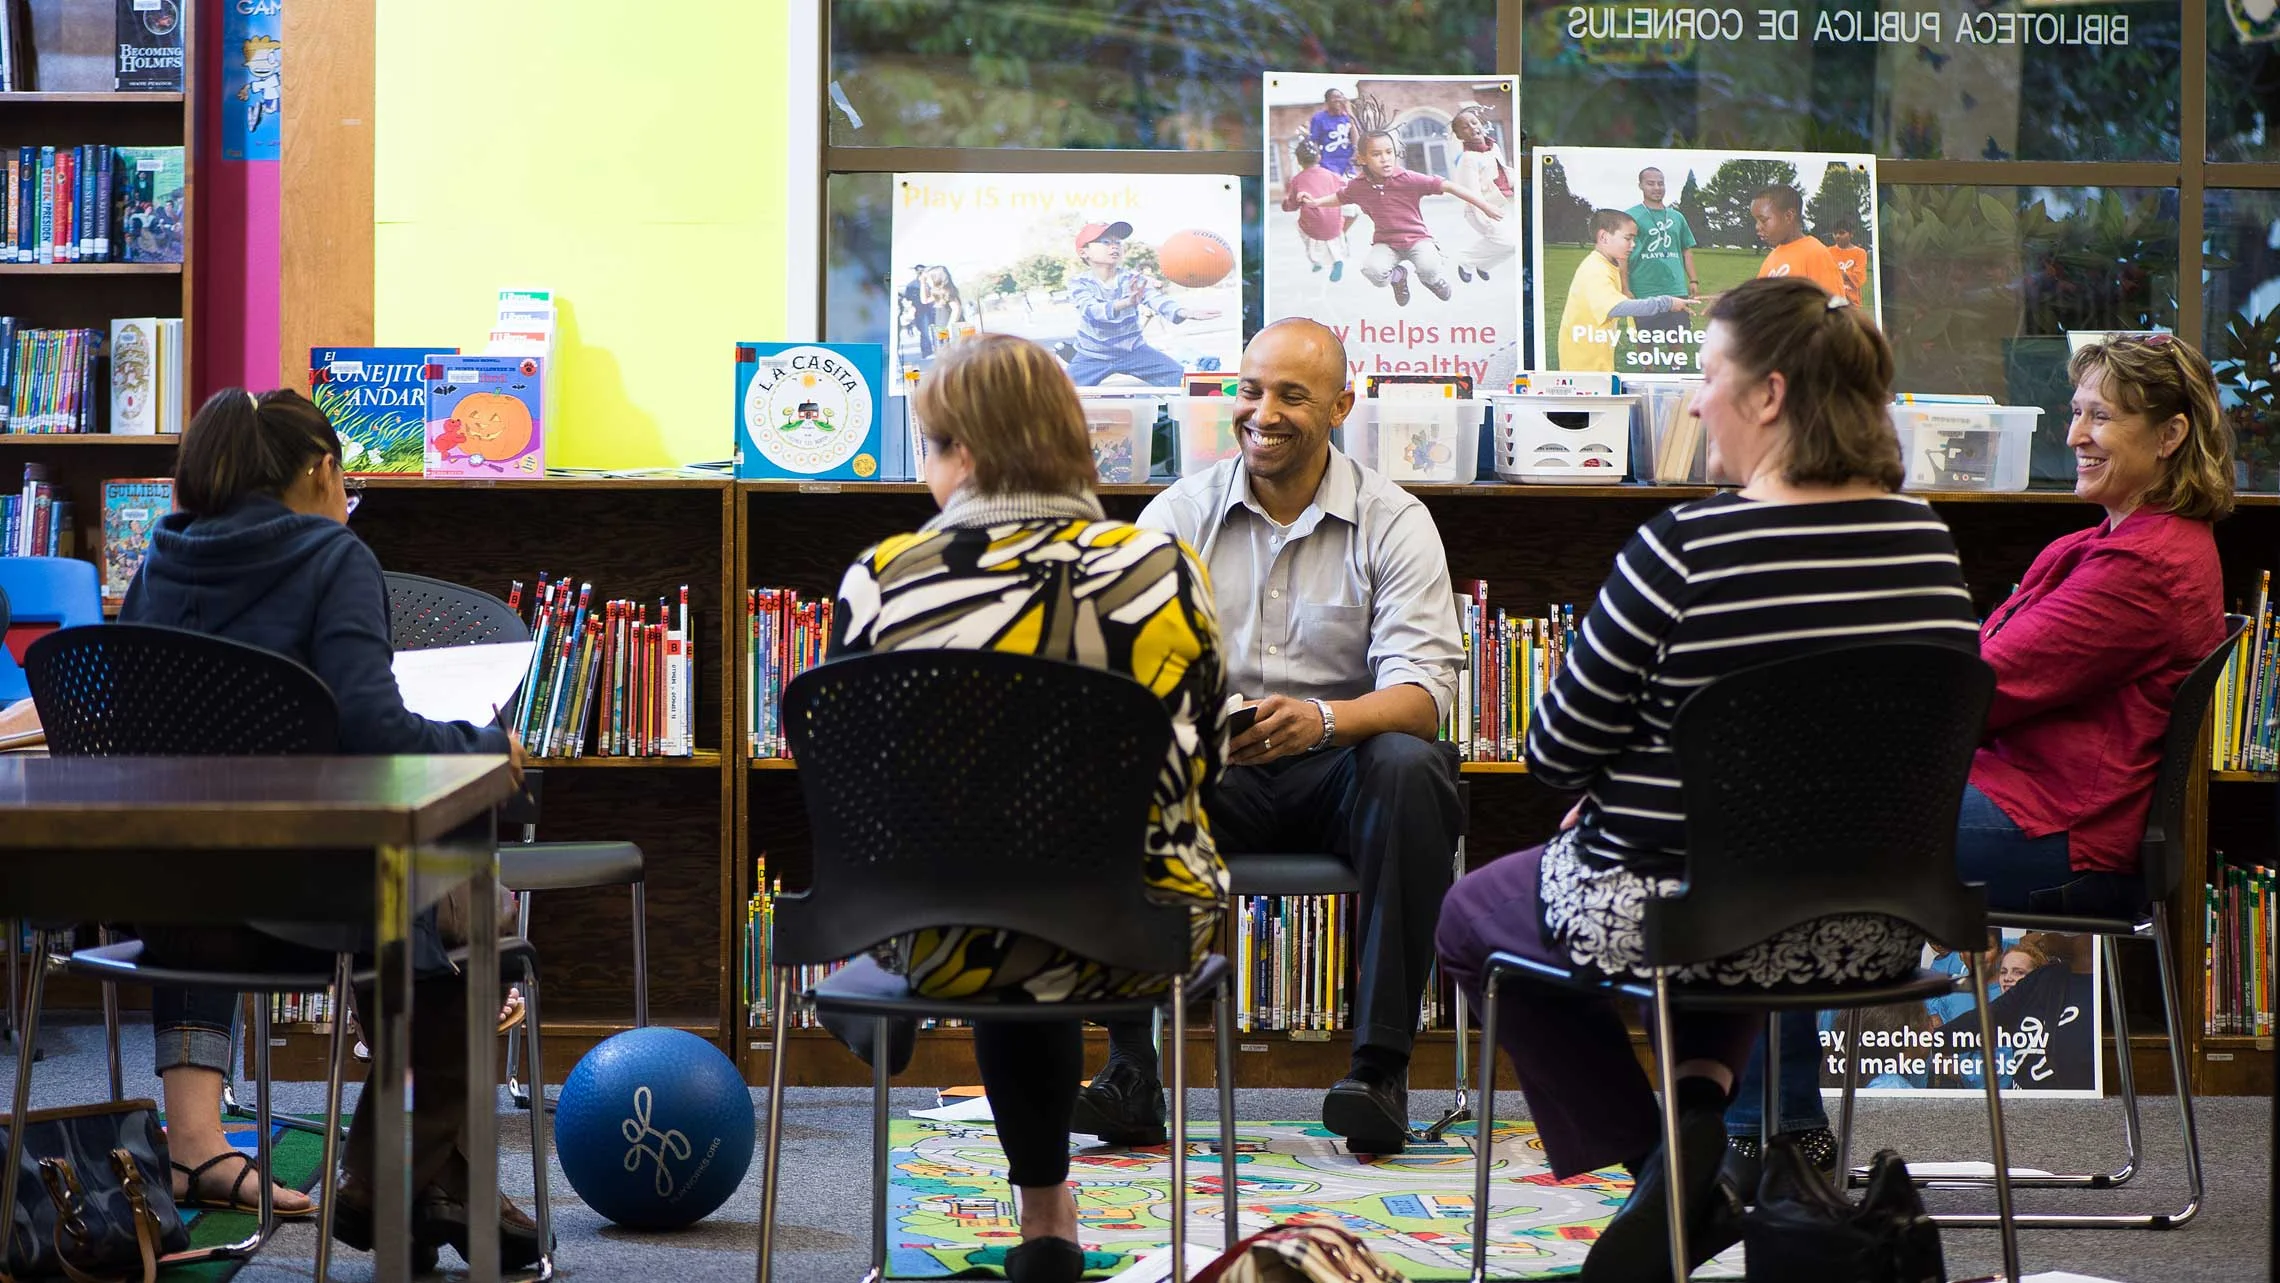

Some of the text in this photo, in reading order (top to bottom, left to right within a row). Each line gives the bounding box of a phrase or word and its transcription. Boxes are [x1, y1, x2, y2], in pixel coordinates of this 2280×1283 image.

[120, 44, 181, 56] BECOMING
[120, 55, 182, 73] HOLMES
[903, 185, 963, 211] Play
[1011, 190, 1053, 211] my
[1065, 186, 1138, 209] work
[41, 205, 52, 242] PRESIDEN
[1360, 319, 1440, 349] helps
[1450, 326, 1496, 344] me
[1572, 324, 1707, 347] Play teache
[1375, 354, 1489, 384] healthy
[1626, 347, 1688, 366] solve
[759, 355, 857, 393] LA CASITA
[1818, 1030, 1845, 1053] ay
[1859, 1025, 1945, 1048] eaches
[1997, 1026, 2050, 1048] how
[1861, 1053, 1926, 1074] make
